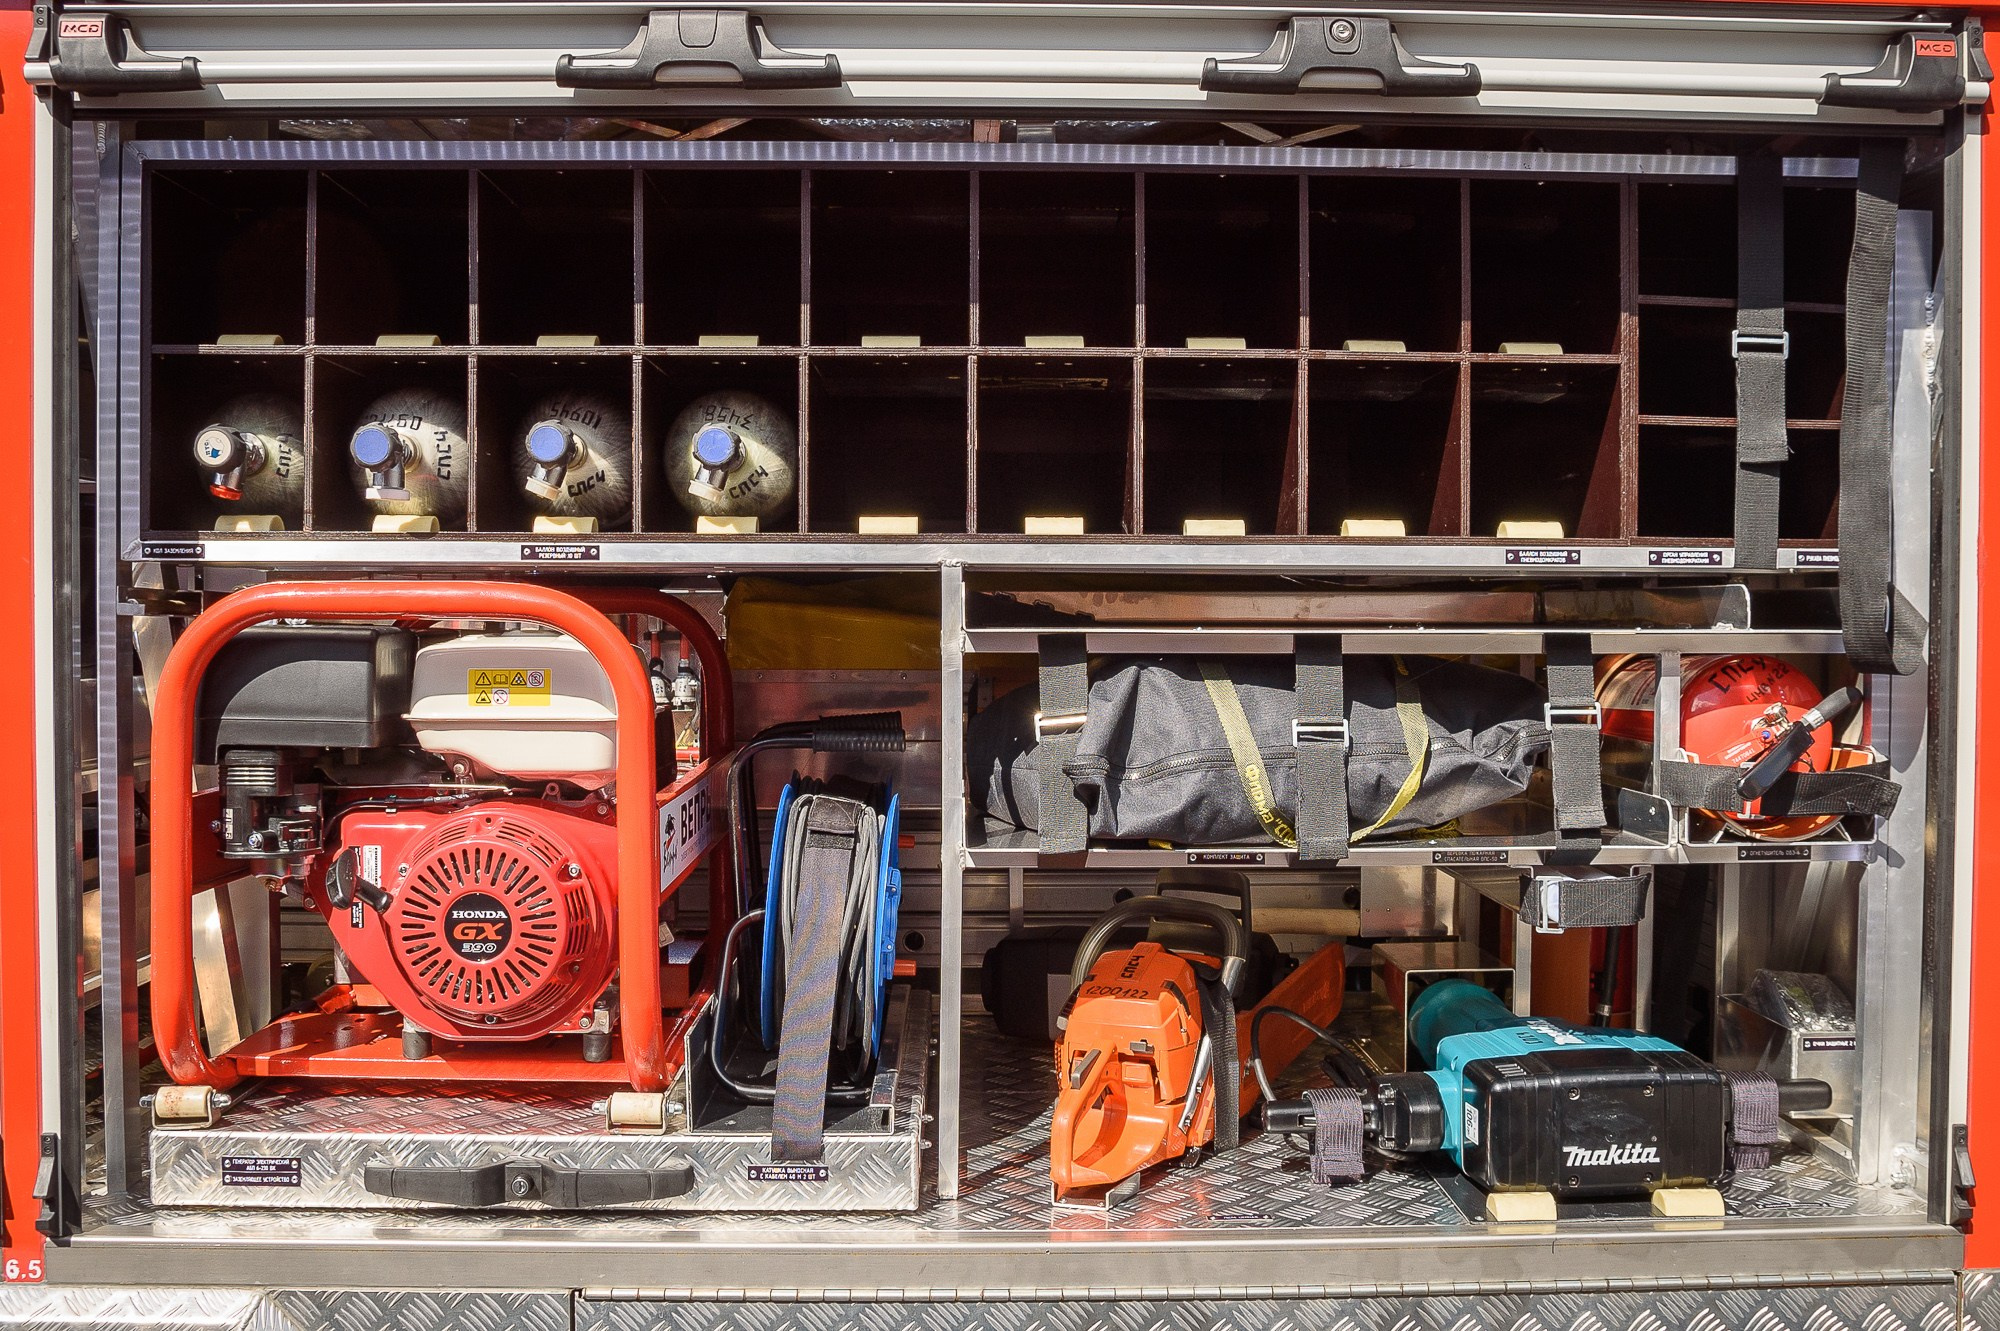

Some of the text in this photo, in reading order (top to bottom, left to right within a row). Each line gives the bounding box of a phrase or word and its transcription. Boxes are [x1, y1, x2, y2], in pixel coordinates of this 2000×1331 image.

[63, 24, 99, 33] MCD
[1919, 44, 1953, 52] MCD
[452, 910, 508, 919] HONDA
[453, 922, 505, 940] GX
[461, 942, 497, 953] 390
[5, 1259, 42, 1280] 6,5
